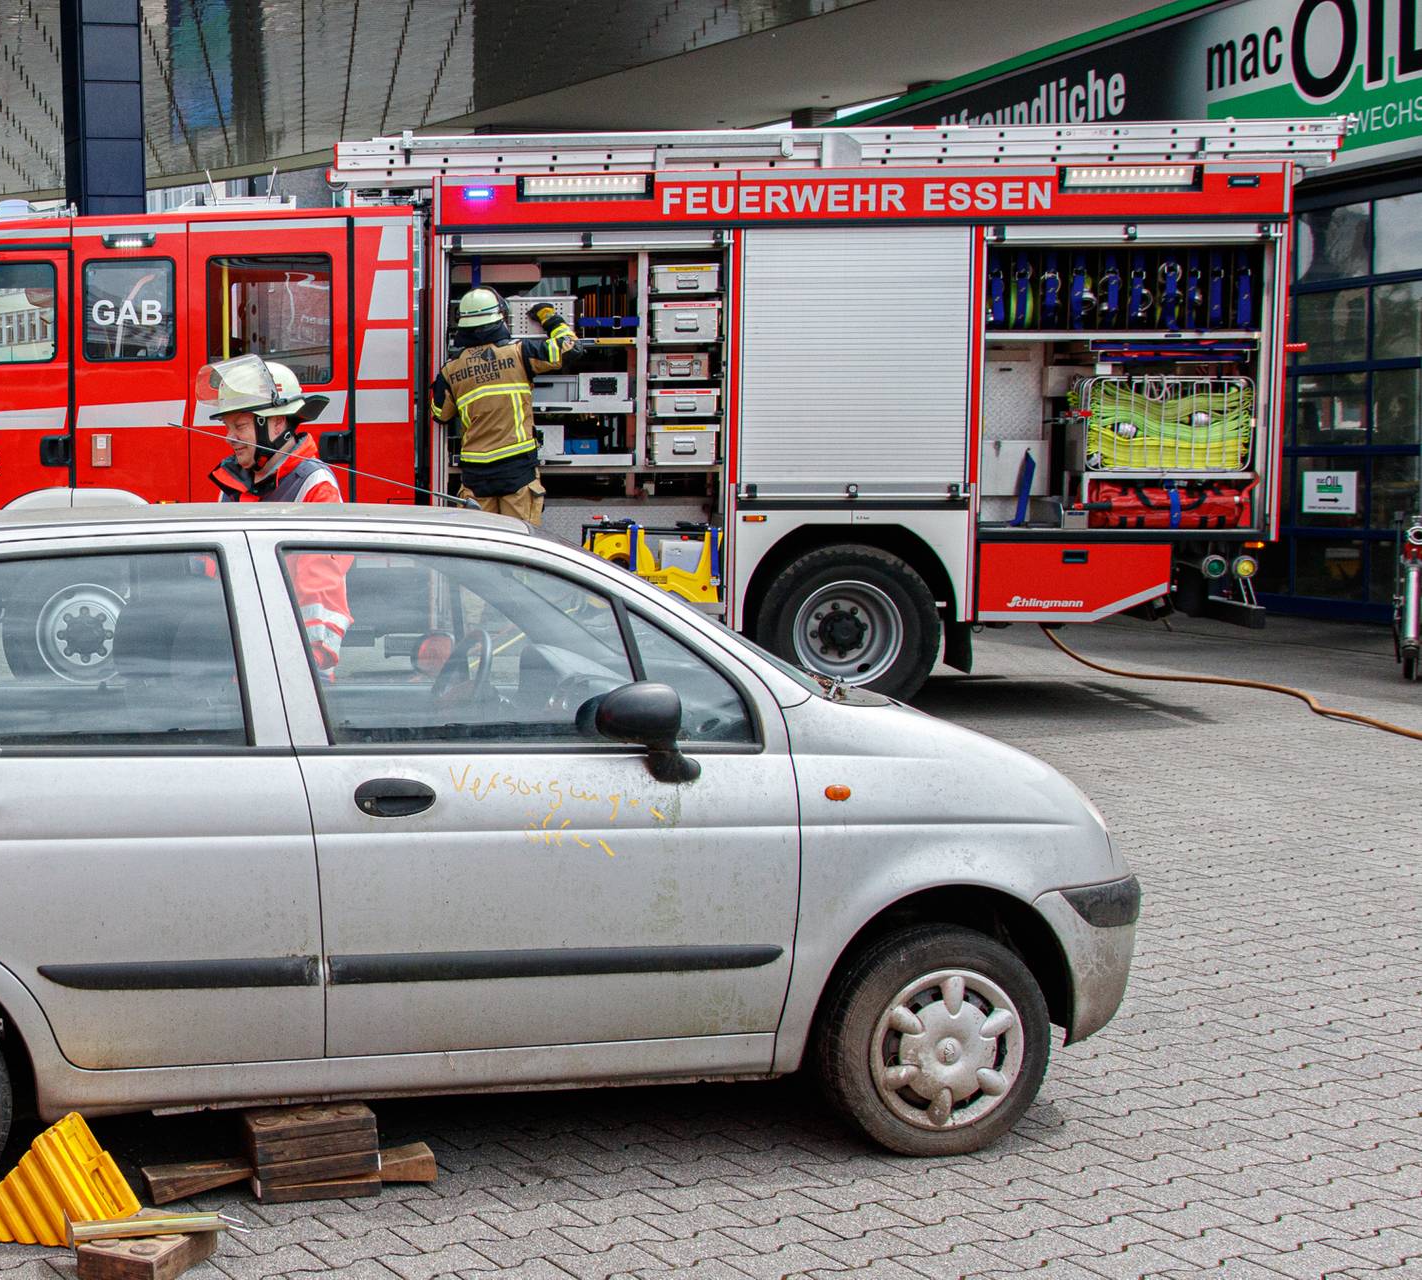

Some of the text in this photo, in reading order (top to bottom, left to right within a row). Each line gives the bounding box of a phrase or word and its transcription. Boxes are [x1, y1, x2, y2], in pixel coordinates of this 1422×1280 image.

[1206, 0, 1422, 98] mac OIL
[662, 181, 1052, 214] FEUERWEHR ESSEN
[91, 299, 163, 326] GAB
[449, 357, 516, 385] FEUERWEHR
[475, 371, 501, 384] ESSEN
[1006, 595, 1084, 609] Schlingmann
